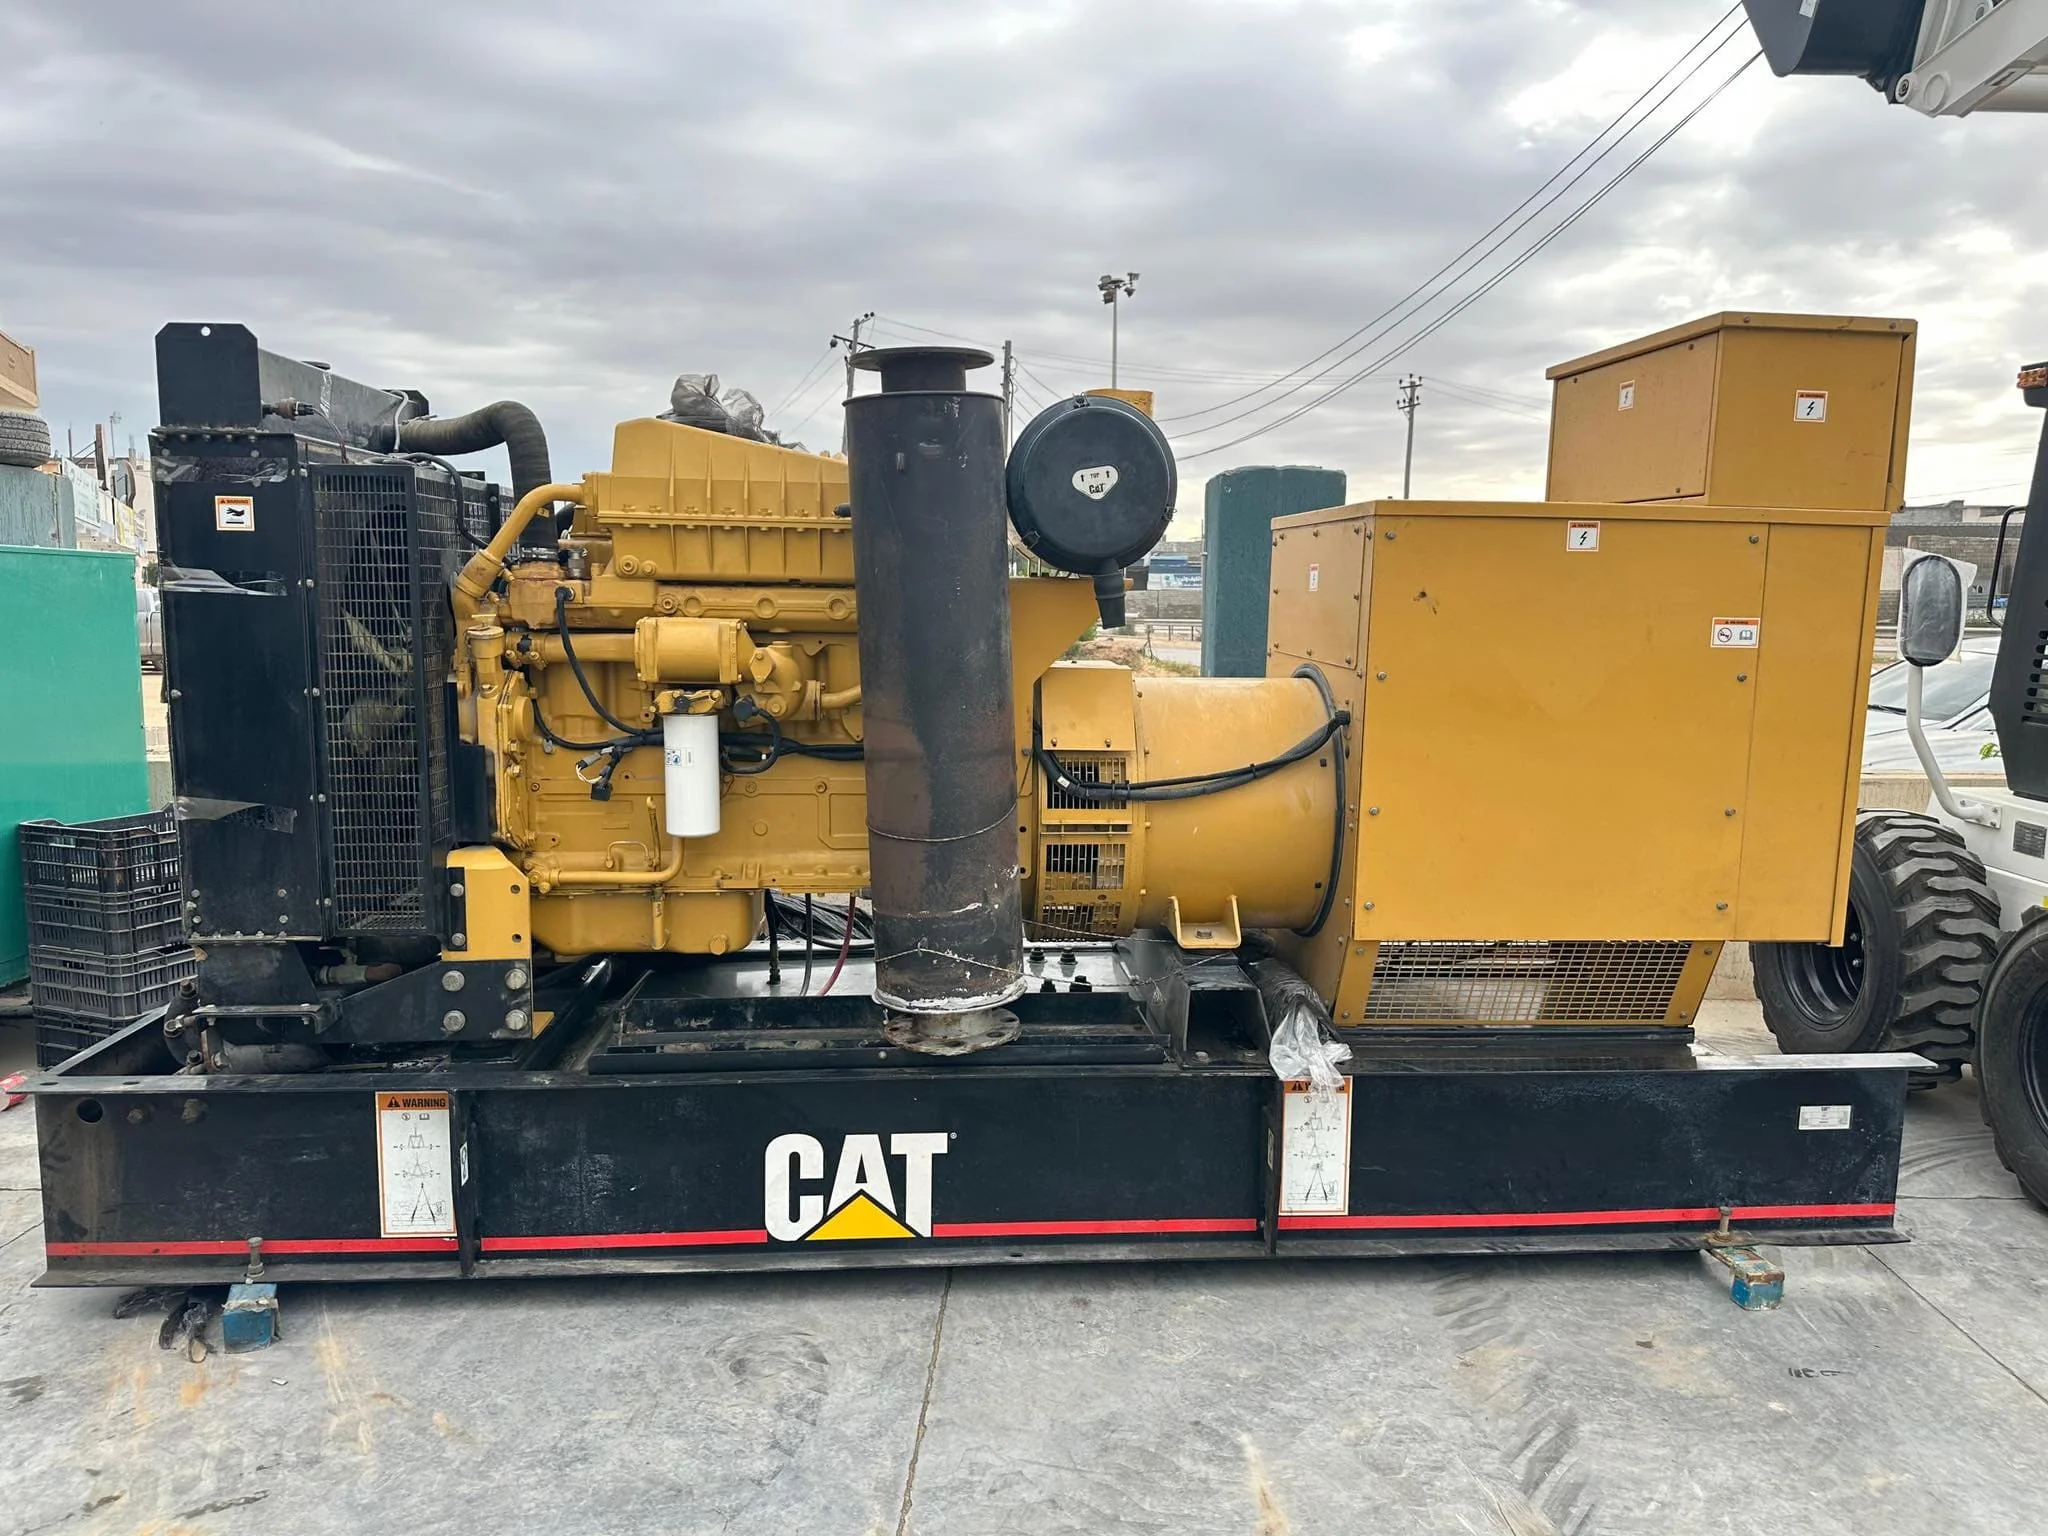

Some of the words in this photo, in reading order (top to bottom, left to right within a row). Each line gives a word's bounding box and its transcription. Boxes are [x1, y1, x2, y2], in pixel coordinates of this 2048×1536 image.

[1089, 483, 1106, 494] CAT
[402, 1097, 446, 1108] WARNING
[764, 1132, 948, 1242] CAT
